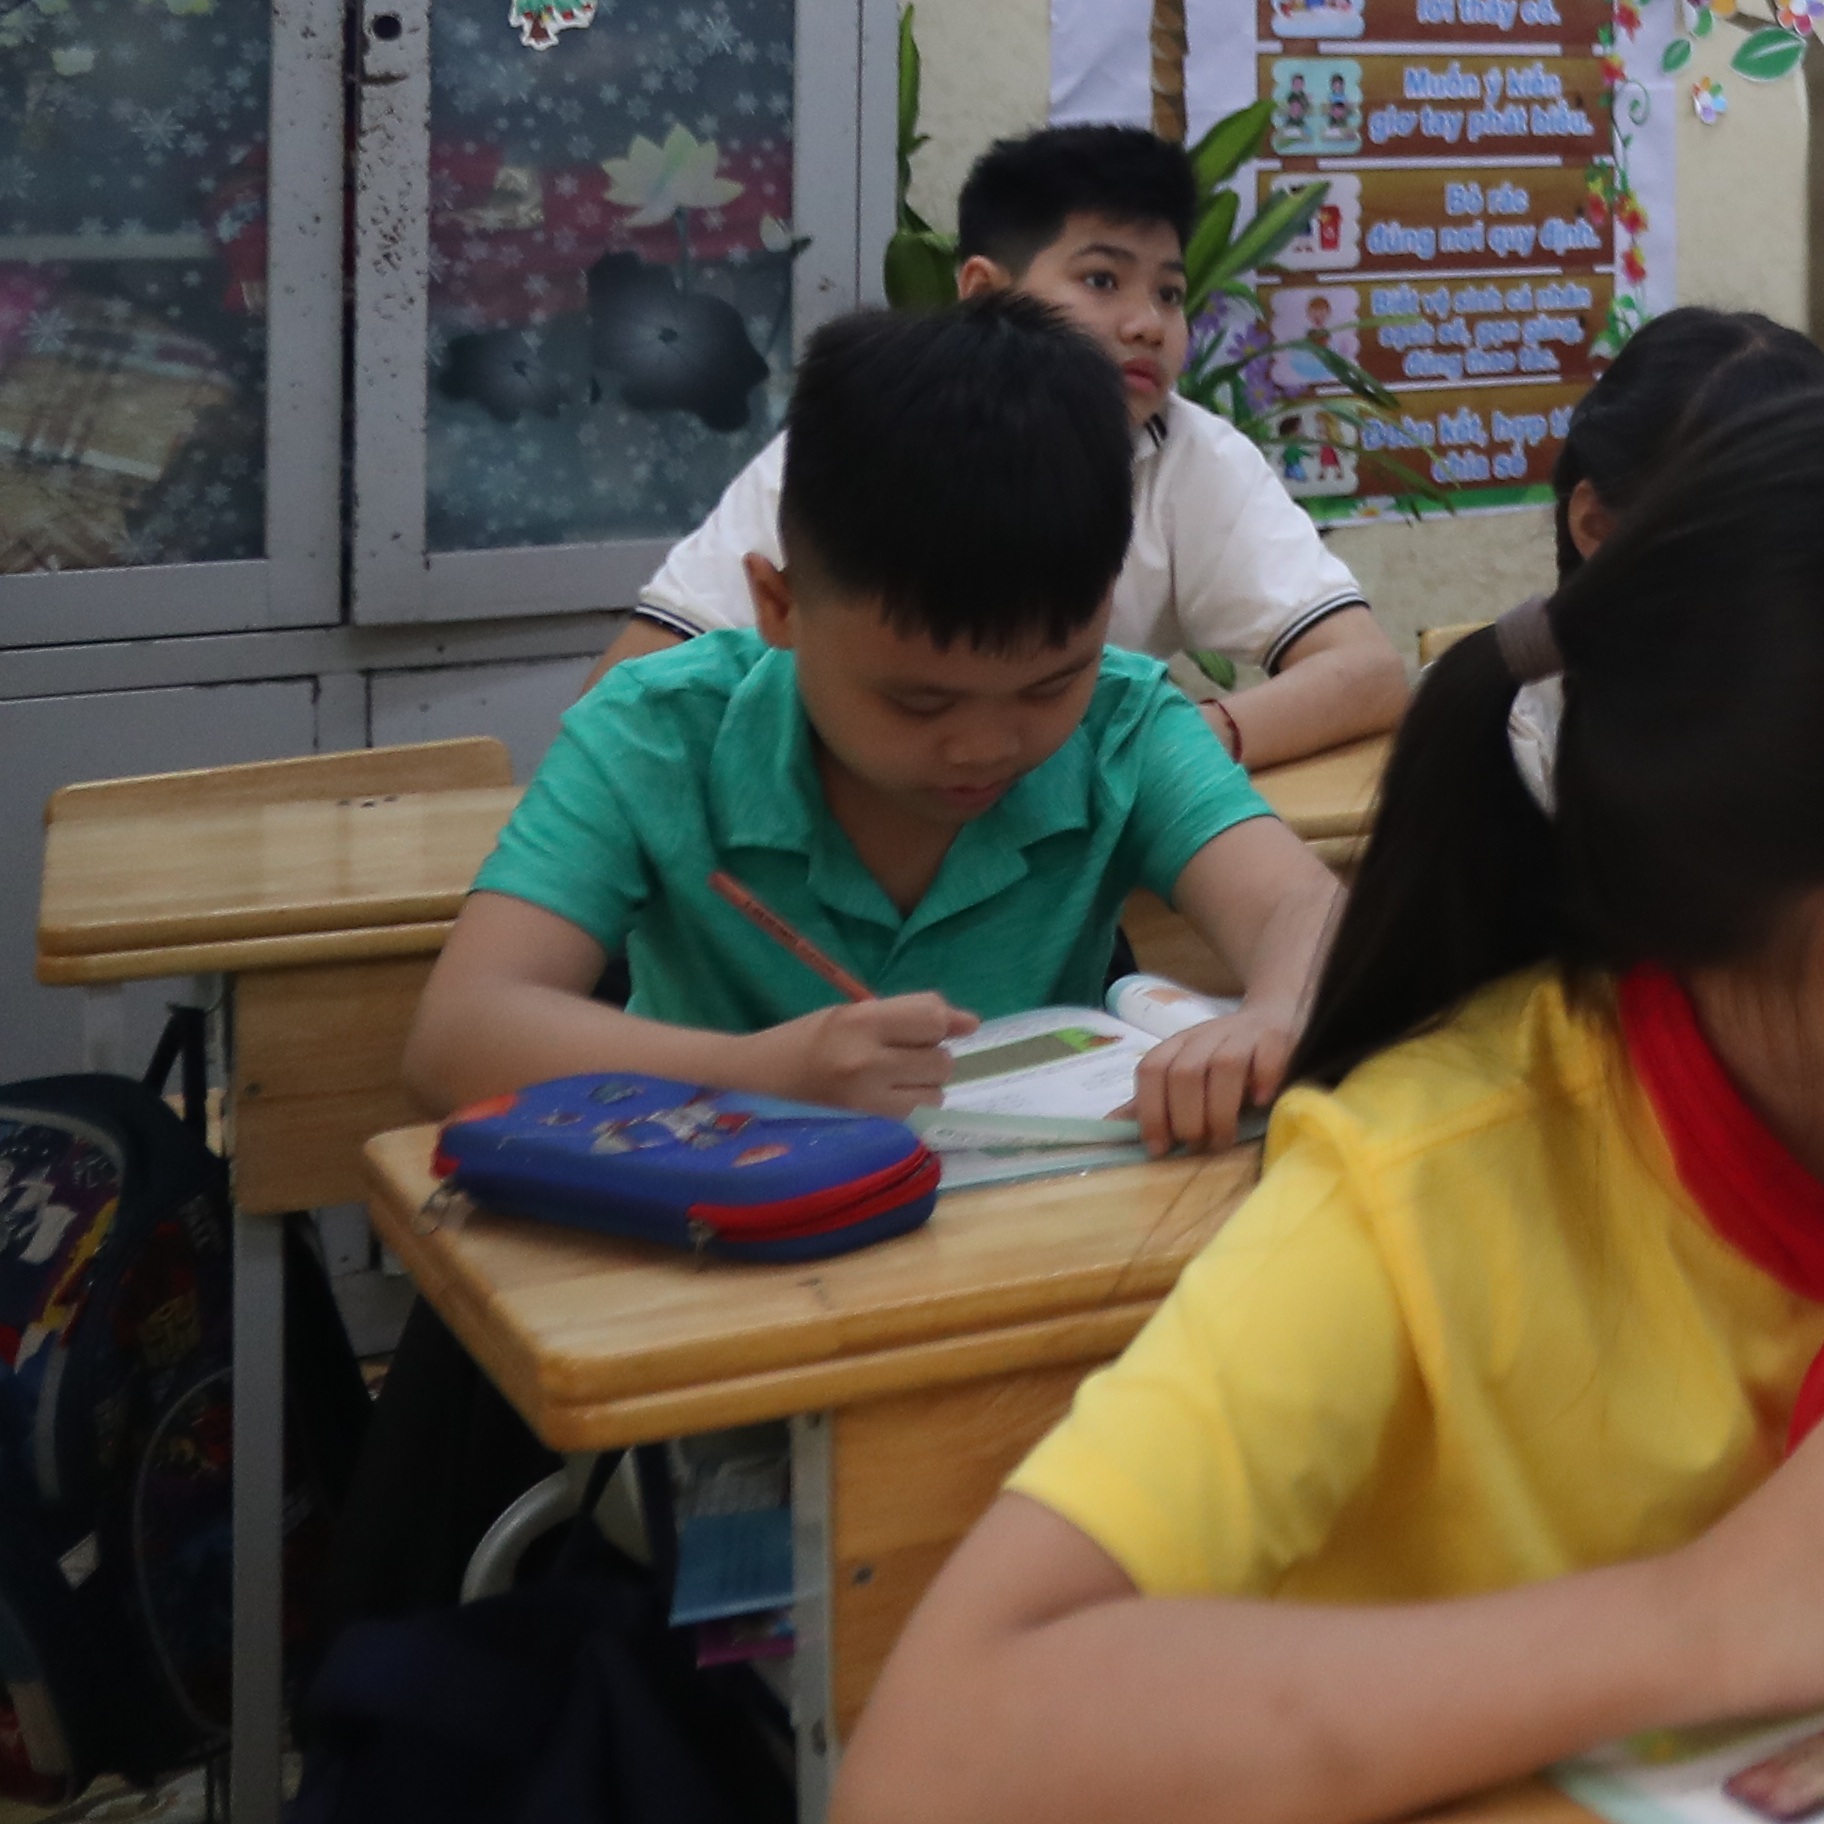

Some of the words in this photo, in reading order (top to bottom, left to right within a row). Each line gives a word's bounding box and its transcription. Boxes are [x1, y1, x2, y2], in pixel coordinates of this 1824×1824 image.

[1403, 61, 1481, 100] Muốn
[1419, 103, 1464, 143] tay
[1444, 181, 1484, 216] Bỏ
[1486, 181, 1529, 215] rác
[1365, 220, 1436, 260] đúng
[1438, 218, 1485, 253] nơi
[1486, 225, 1536, 258] quy
